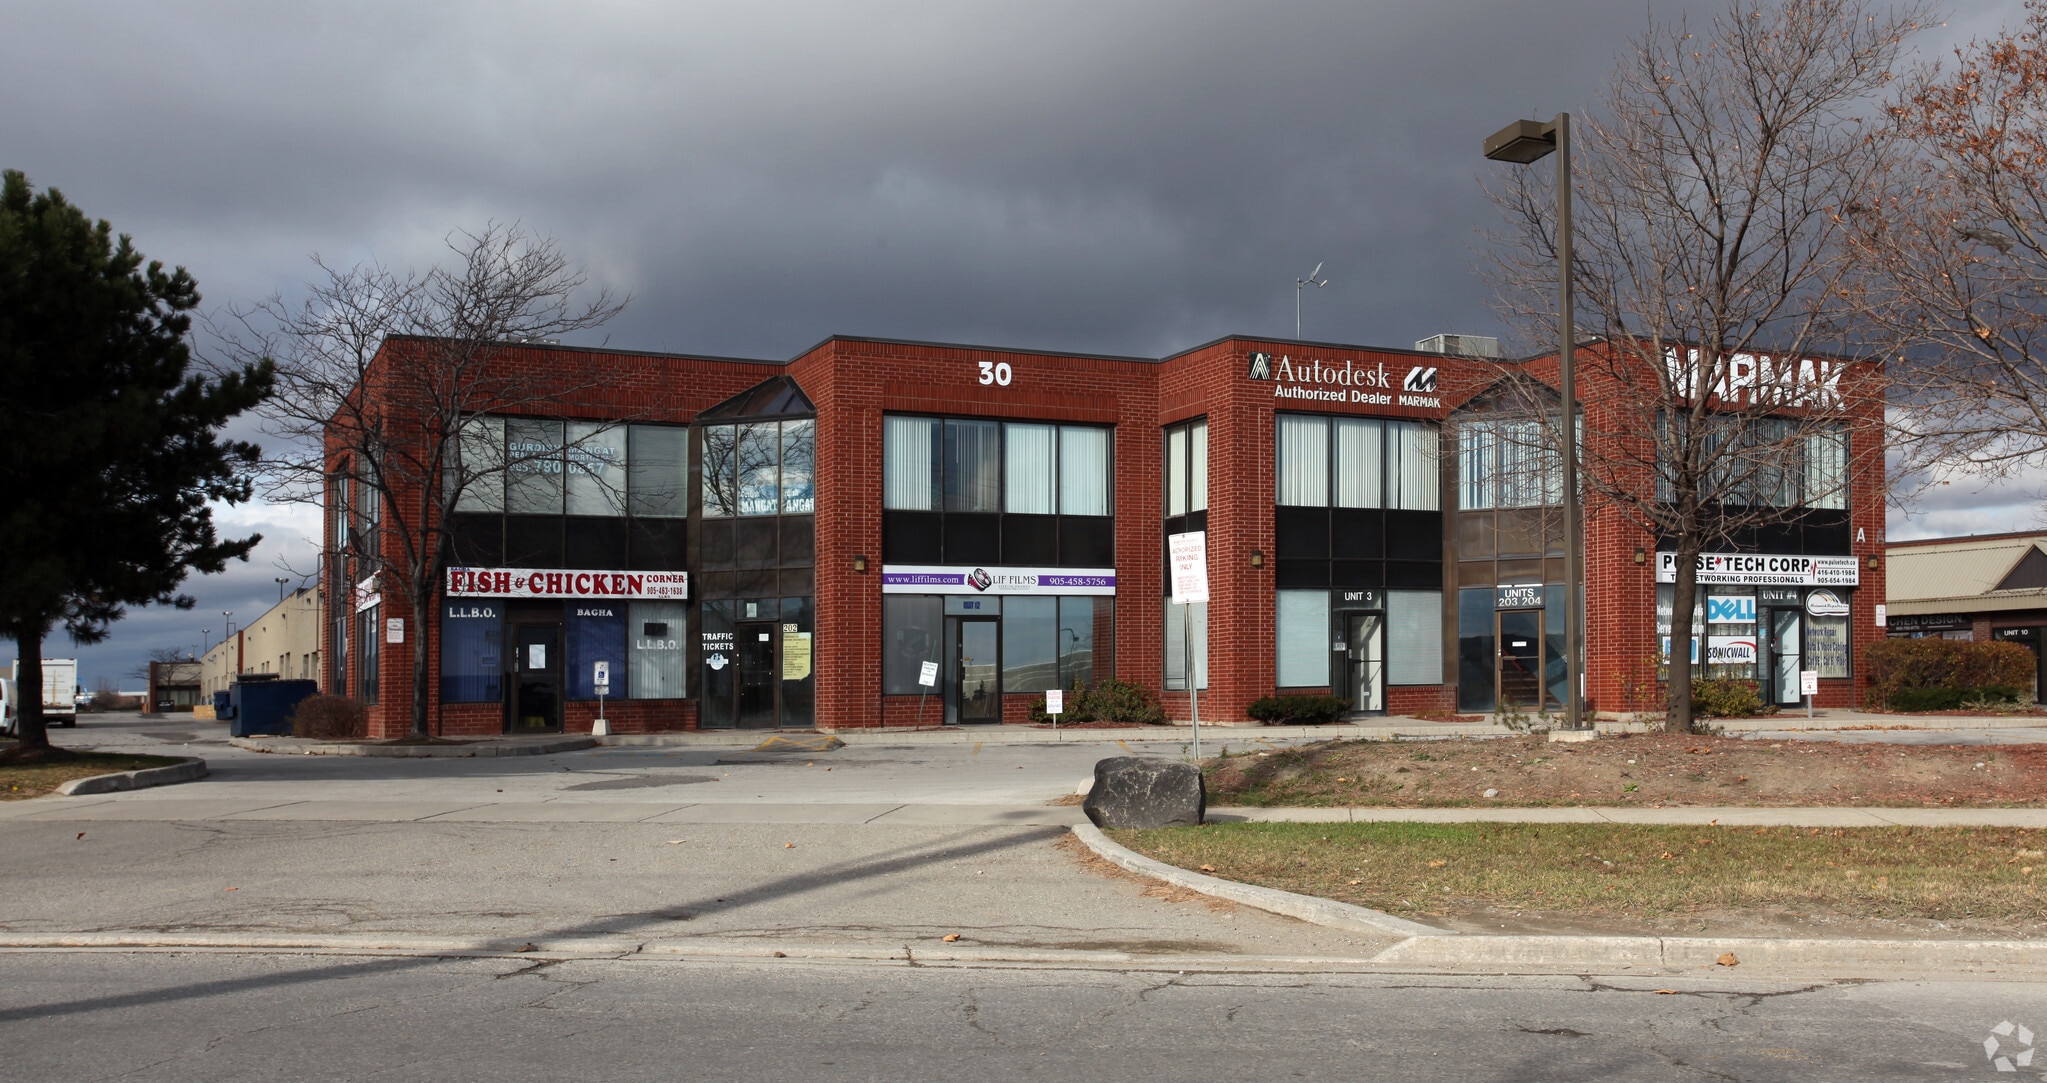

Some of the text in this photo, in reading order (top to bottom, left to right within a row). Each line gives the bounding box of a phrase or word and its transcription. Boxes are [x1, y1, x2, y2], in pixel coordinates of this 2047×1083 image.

[978, 361, 1012, 386] 30
[1275, 355, 1391, 389] Autodesk
[1275, 385, 1392, 405] Authorized Dealer
[1399, 395, 1441, 408] MARMAK
[1856, 528, 1866, 543] A
[1724, 557, 1765, 572] TECH
[1769, 558, 1810, 572] CORP.
[450, 572, 644, 595] FISH & CHICKEN
[647, 574, 685, 583] CORNER
[888, 575, 959, 584] www.liffilms.com
[993, 575, 1037, 585] LIF FILMS
[1049, 576, 1107, 587] 905-458-5756
[1743, 576, 1804, 584] PROFESSIONALS
[1344, 592, 1372, 601] UNIT 3
[1504, 588, 1534, 598] UNITS
[1763, 590, 1784, 600] UNIT
[1498, 596, 1541, 607] 203 204
[449, 607, 496, 618] L.L.B.O.
[577, 608, 613, 617] BAGHA
[1708, 599, 1756, 620] DELL
[783, 624, 797, 632] 202
[636, 640, 680, 650] L.L.B.O.
